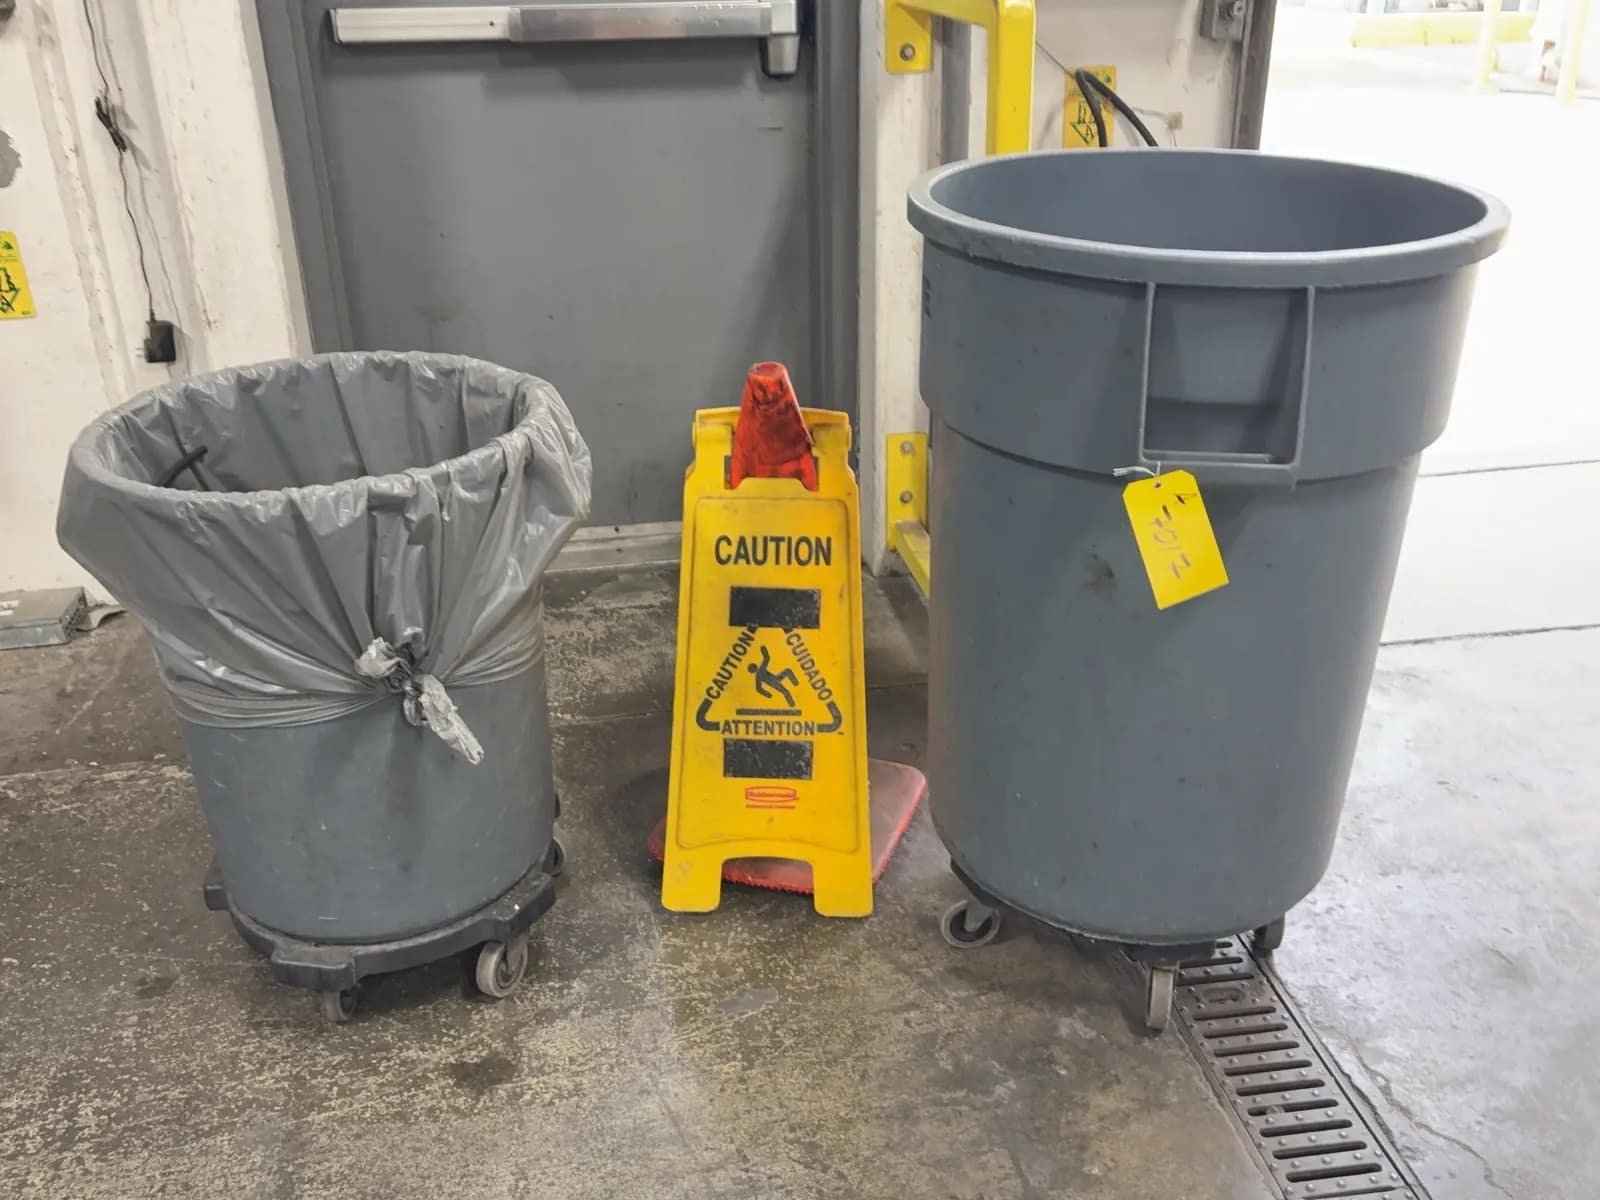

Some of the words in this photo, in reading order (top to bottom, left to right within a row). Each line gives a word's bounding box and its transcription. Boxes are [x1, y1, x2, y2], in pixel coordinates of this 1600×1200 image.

[715, 535, 832, 566] CAUTION
[705, 632, 755, 700] CAUTION
[786, 633, 832, 701] CUIDADO
[721, 719, 815, 736] ATTENTION
